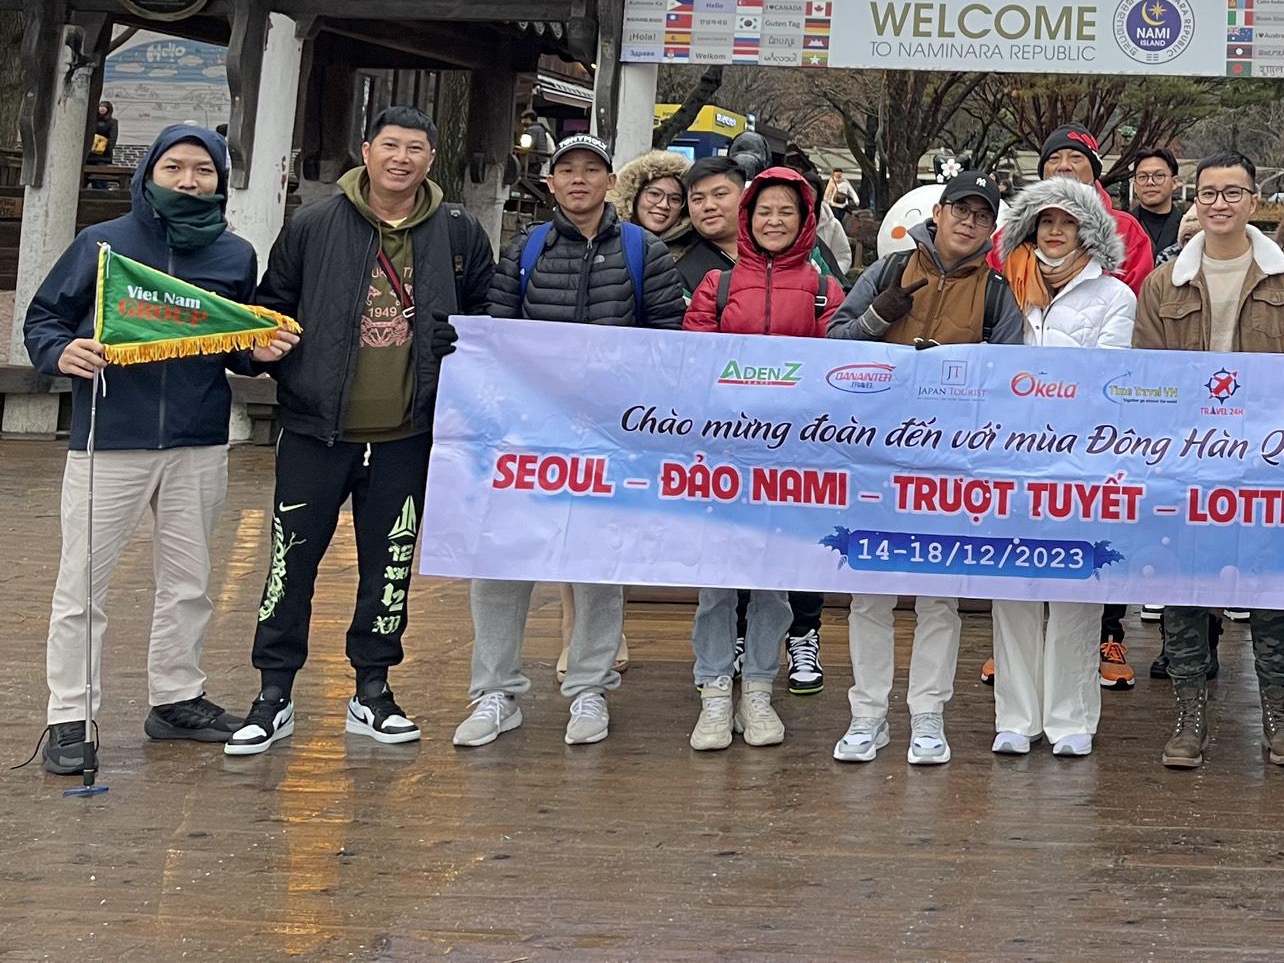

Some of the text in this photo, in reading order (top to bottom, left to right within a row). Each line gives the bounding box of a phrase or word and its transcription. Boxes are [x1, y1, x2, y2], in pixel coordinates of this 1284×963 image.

[788, 21, 801, 29] Tag
[869, 1, 1098, 42] WELCOME
[1136, 27, 1170, 39] NAMI
[870, 41, 1097, 62] TO NAMINARA REPUBLIC
[1140, 39, 1166, 47] ISLAND
[127, 284, 201, 310] Viet Nam
[117, 297, 209, 327] GROUP
[368, 306, 398, 318] 1949
[946, 365, 962, 380] JT
[918, 387, 988, 398] JAPAN TOURIST
[1010, 371, 1078, 399] Okela
[1134, 385, 1161, 397] Travel
[1200, 406, 1243, 416] TRAVEL 24H
[620, 404, 694, 435] Chào
[701, 411, 793, 449] mừng
[800, 414, 877, 447] đoàn
[885, 416, 943, 450] đến
[951, 420, 1002, 451] với
[1004, 423, 1079, 454] mùa
[1085, 424, 1172, 466] Đông
[1179, 427, 1250, 461] Hàn
[492, 453, 613, 494] SEOUL
[660, 453, 740, 501] ĐẢO
[751, 467, 848, 507] NAMI
[893, 474, 1016, 524] TRƯỢT
[1026, 471, 1144, 521] TUYẾT
[857, 537, 1085, 570] 14-18/12/2023
